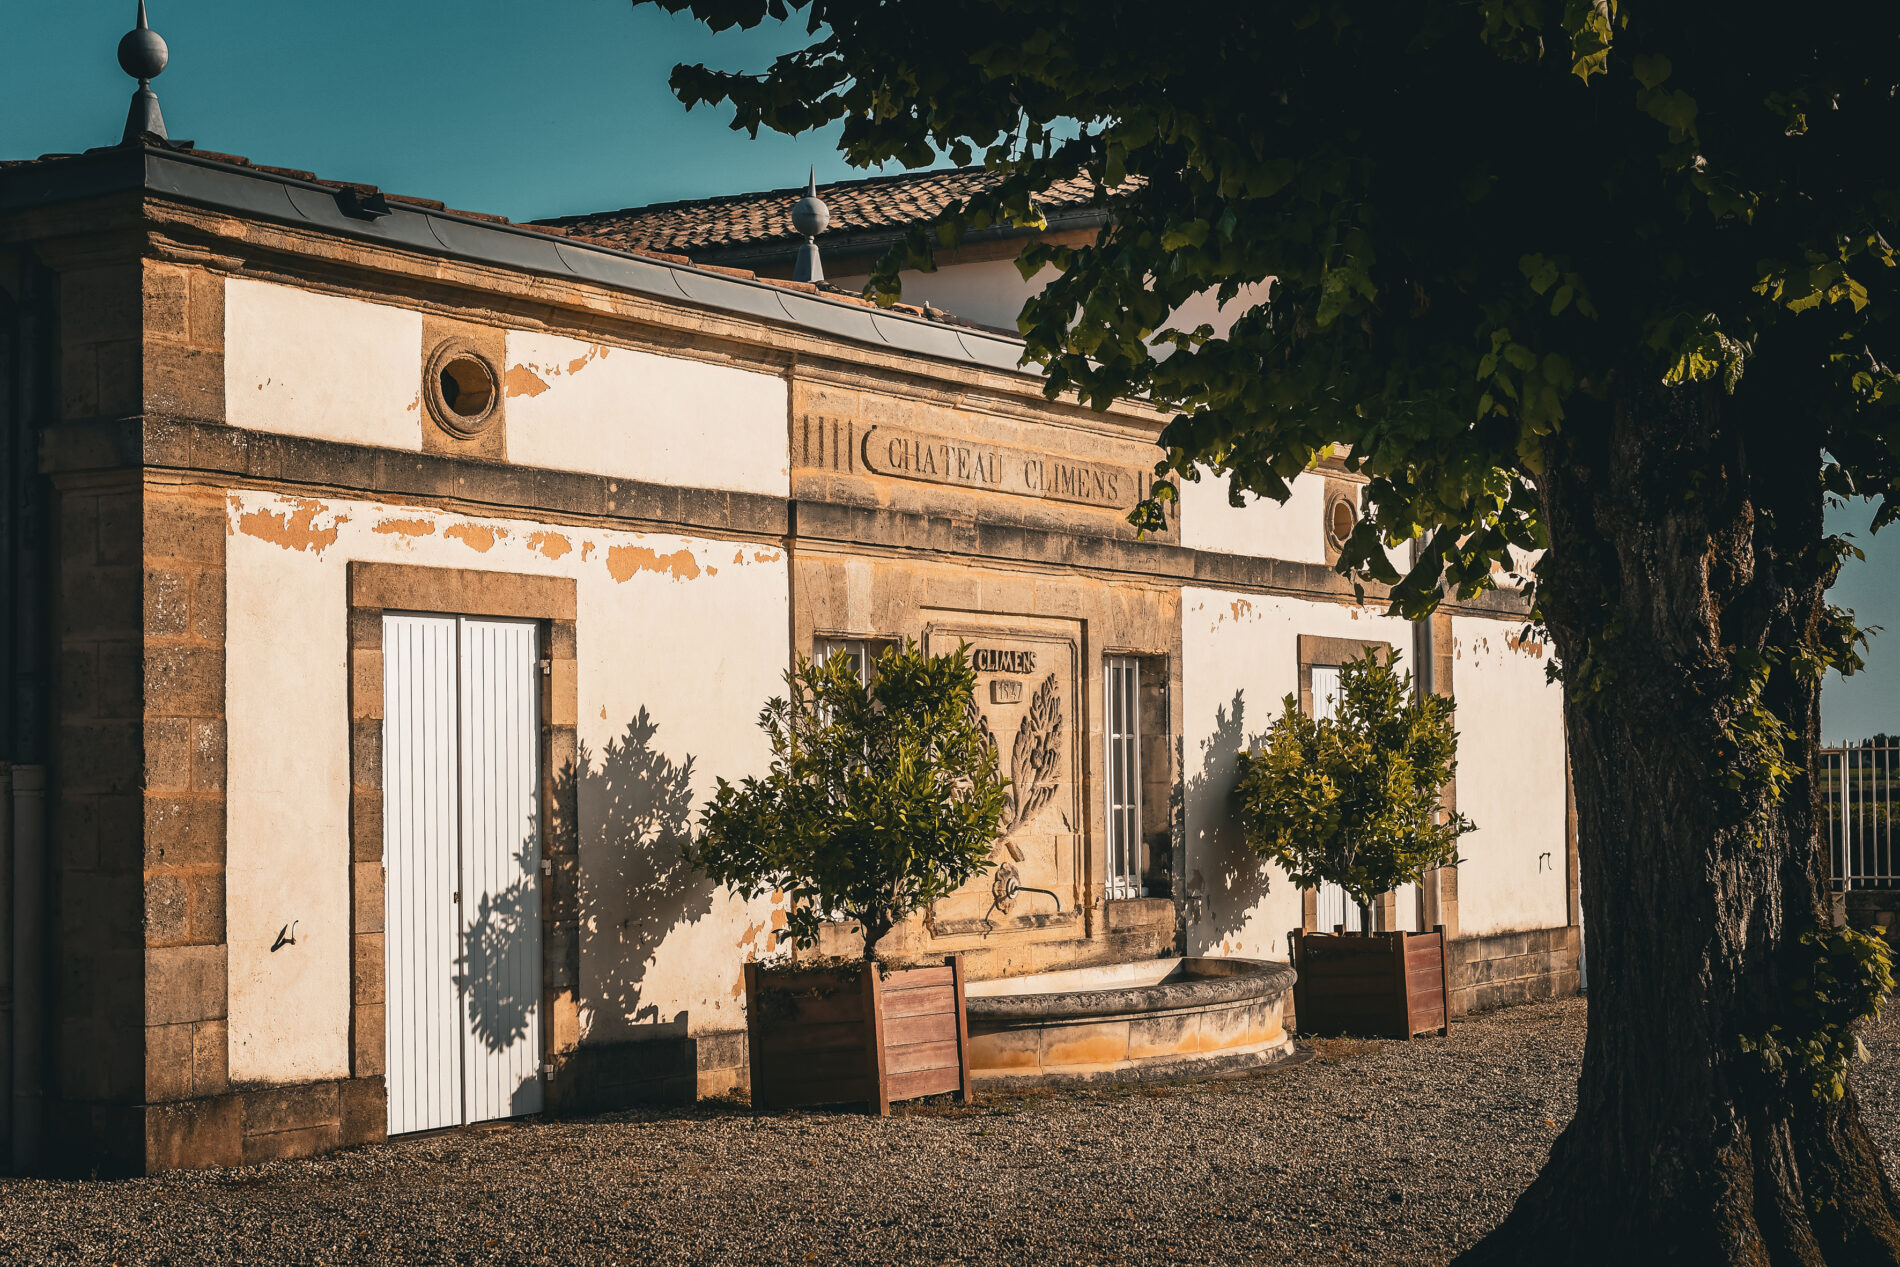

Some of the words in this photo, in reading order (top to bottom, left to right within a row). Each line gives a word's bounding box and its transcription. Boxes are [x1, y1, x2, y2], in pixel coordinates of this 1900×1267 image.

[888, 437, 1003, 484] CHATEAU
[1024, 460, 1119, 500] CLIMENS
[975, 648, 1038, 672] CLIMENS
